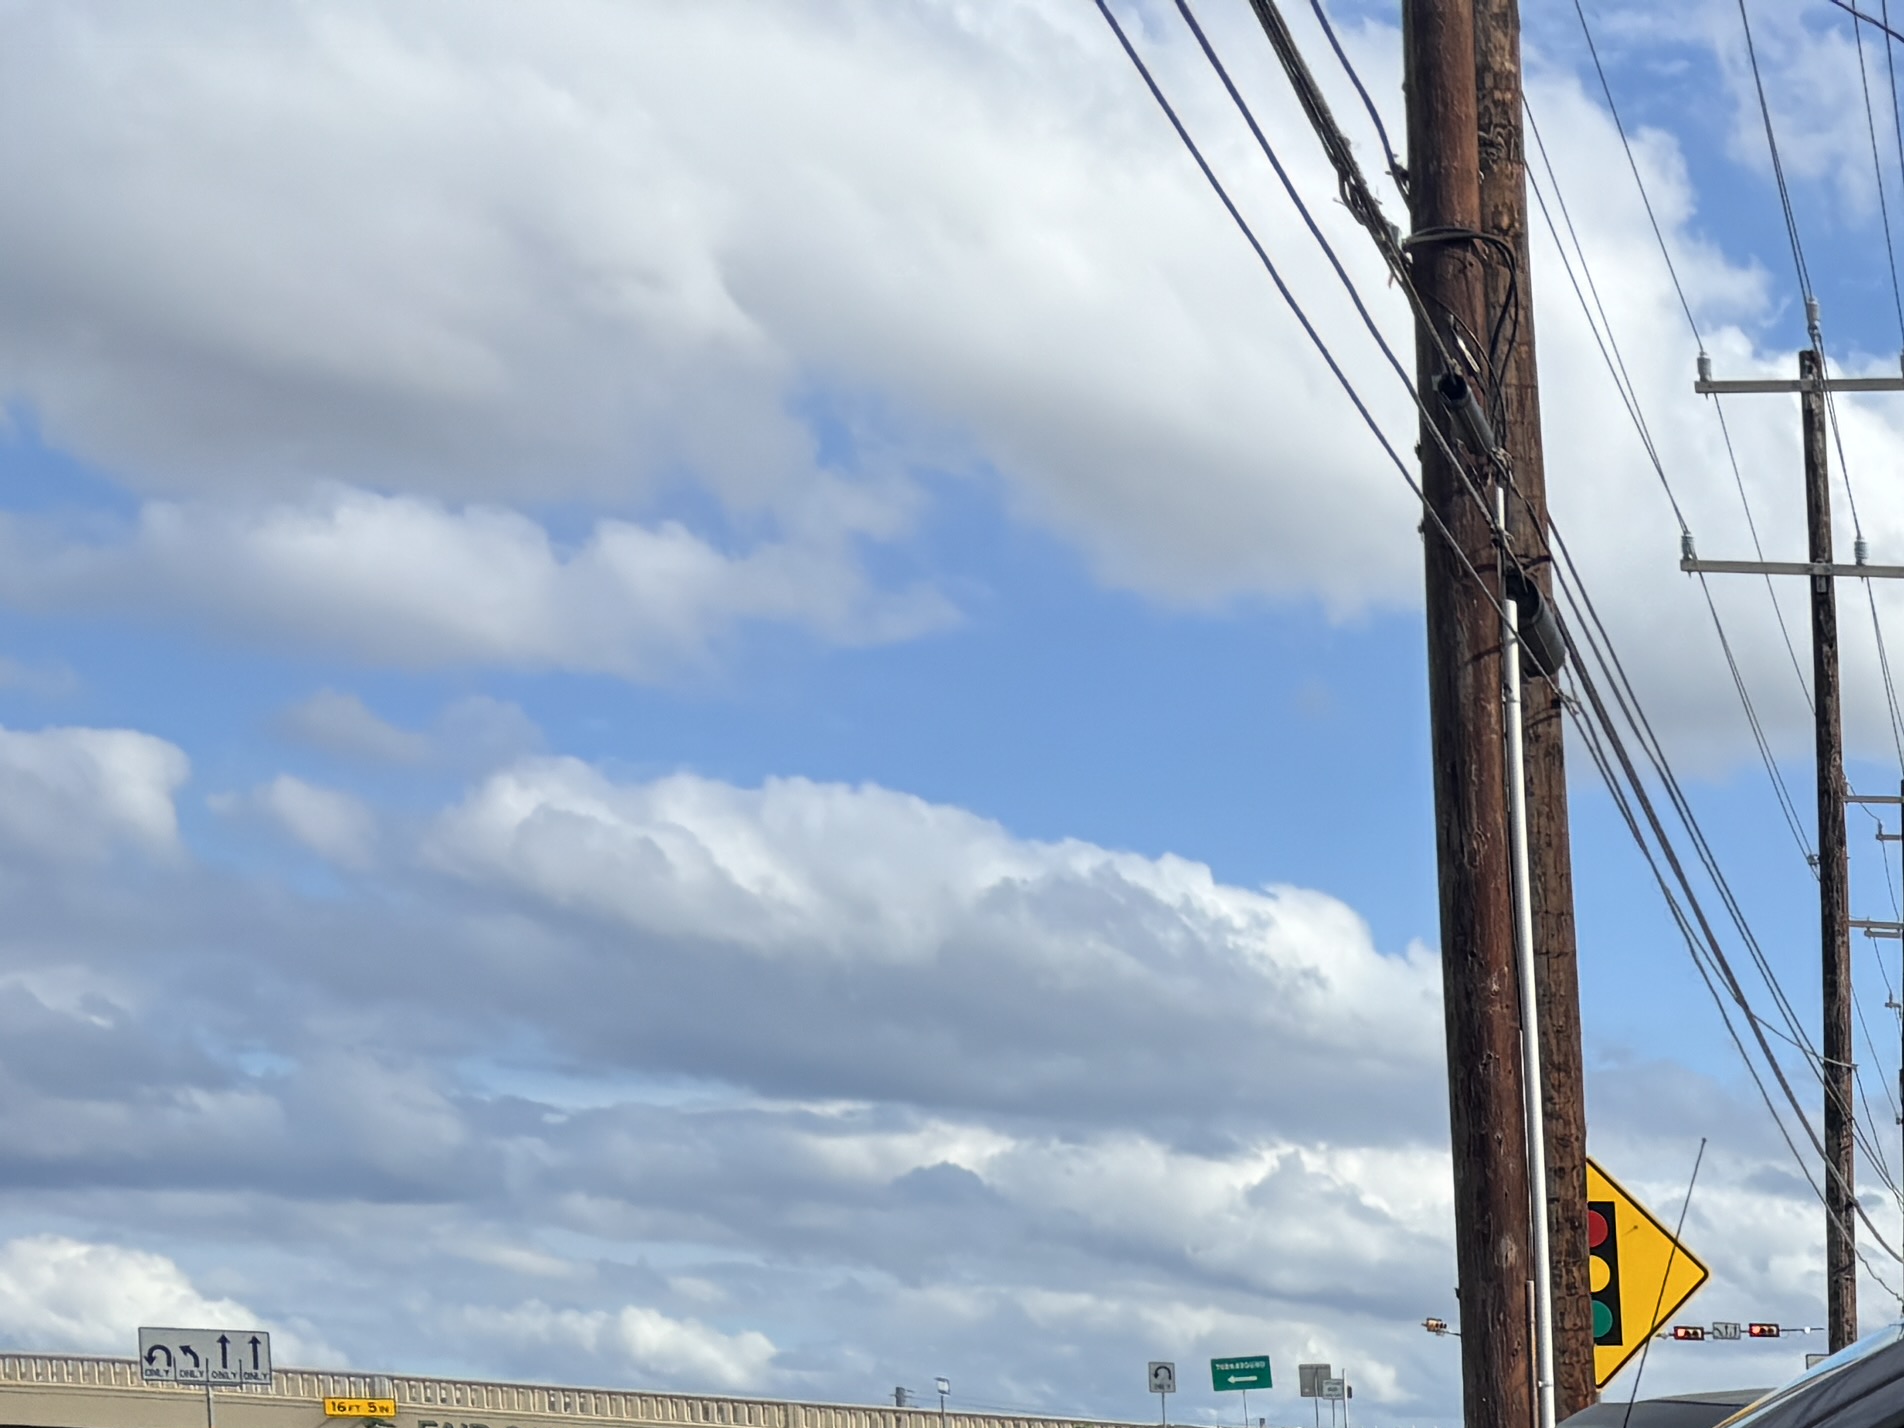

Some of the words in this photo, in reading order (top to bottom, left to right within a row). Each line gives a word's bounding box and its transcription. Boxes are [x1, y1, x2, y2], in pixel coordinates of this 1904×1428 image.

[144, 1368, 170, 1378] ONLY
[179, 1369, 205, 1379] ONLY
[211, 1370, 238, 1380] ONLY
[243, 1371, 269, 1381] ONLY
